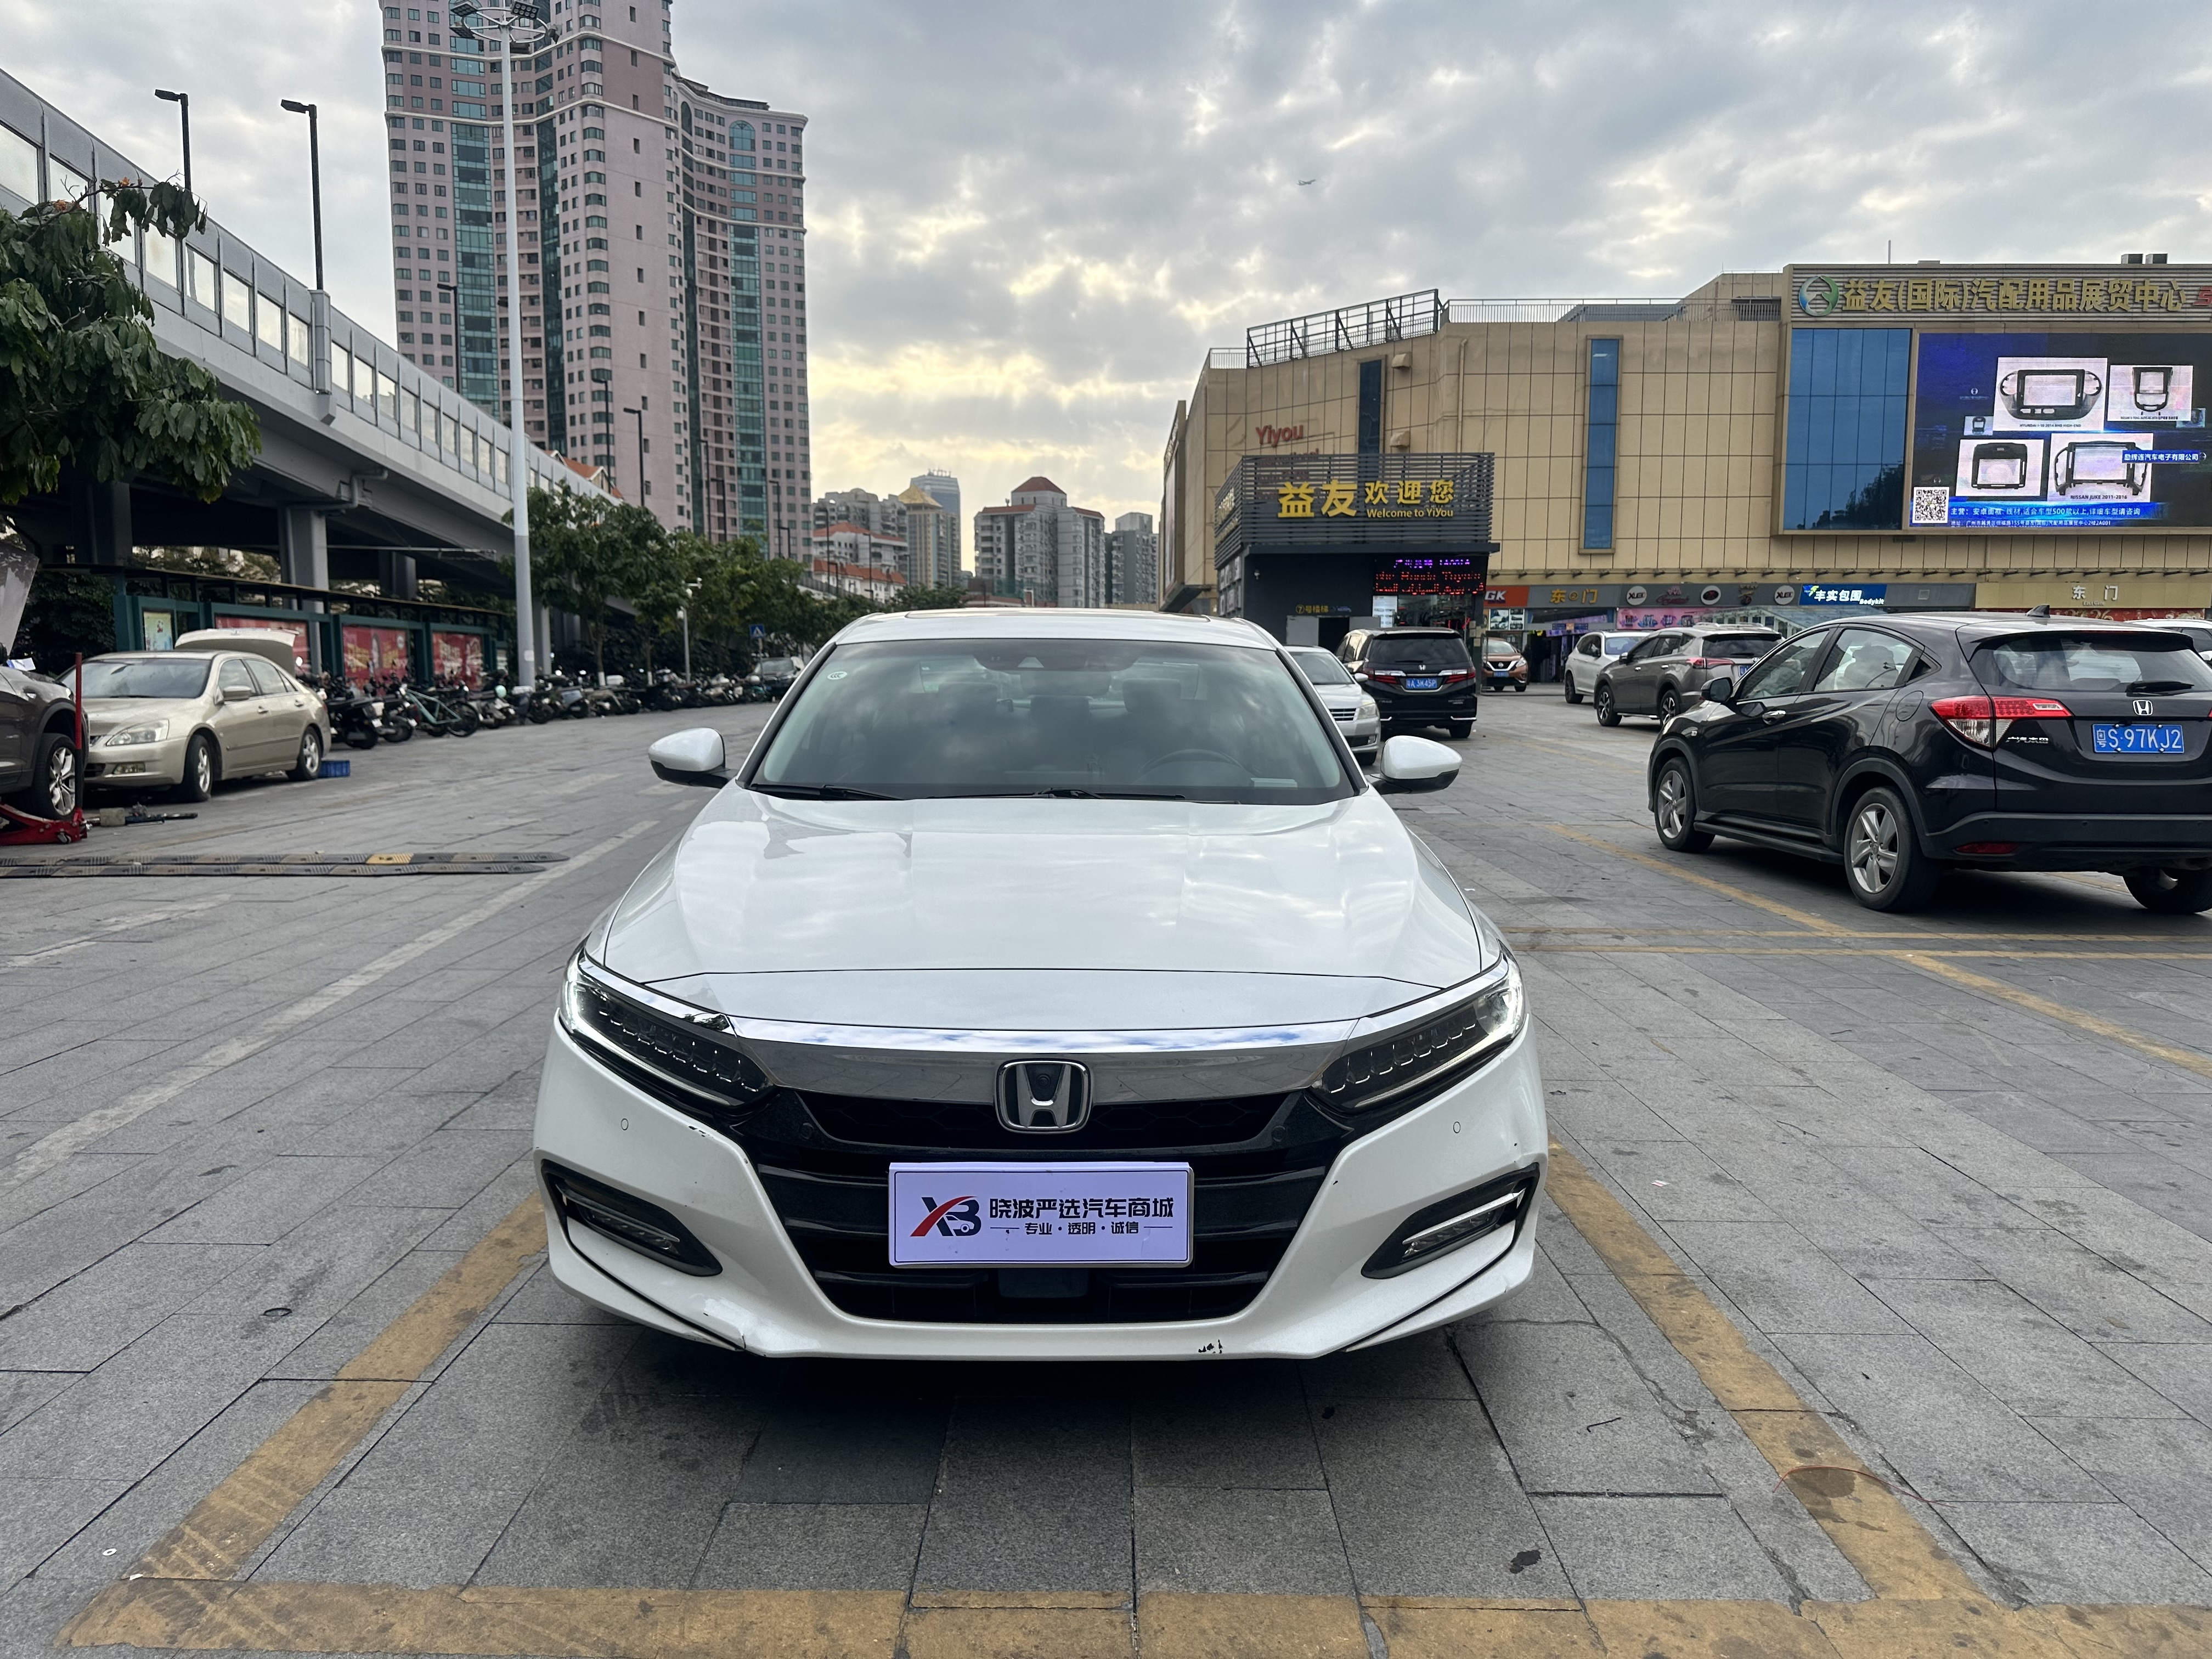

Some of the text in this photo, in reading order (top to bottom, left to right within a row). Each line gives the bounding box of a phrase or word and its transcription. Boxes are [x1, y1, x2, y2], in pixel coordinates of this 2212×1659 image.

[1842, 279, 2186, 312] 益友(国际)汽配用品展贸中心
[1255, 425, 1304, 448] Yiyou
[1278, 479, 1454, 517] 益友 欢迎您
[1367, 508, 1454, 518] Welcome to YiYou
[1814, 590, 1863, 602] 丰实包围
[989, 1197, 1174, 1219] 晓波严选汽车商城
